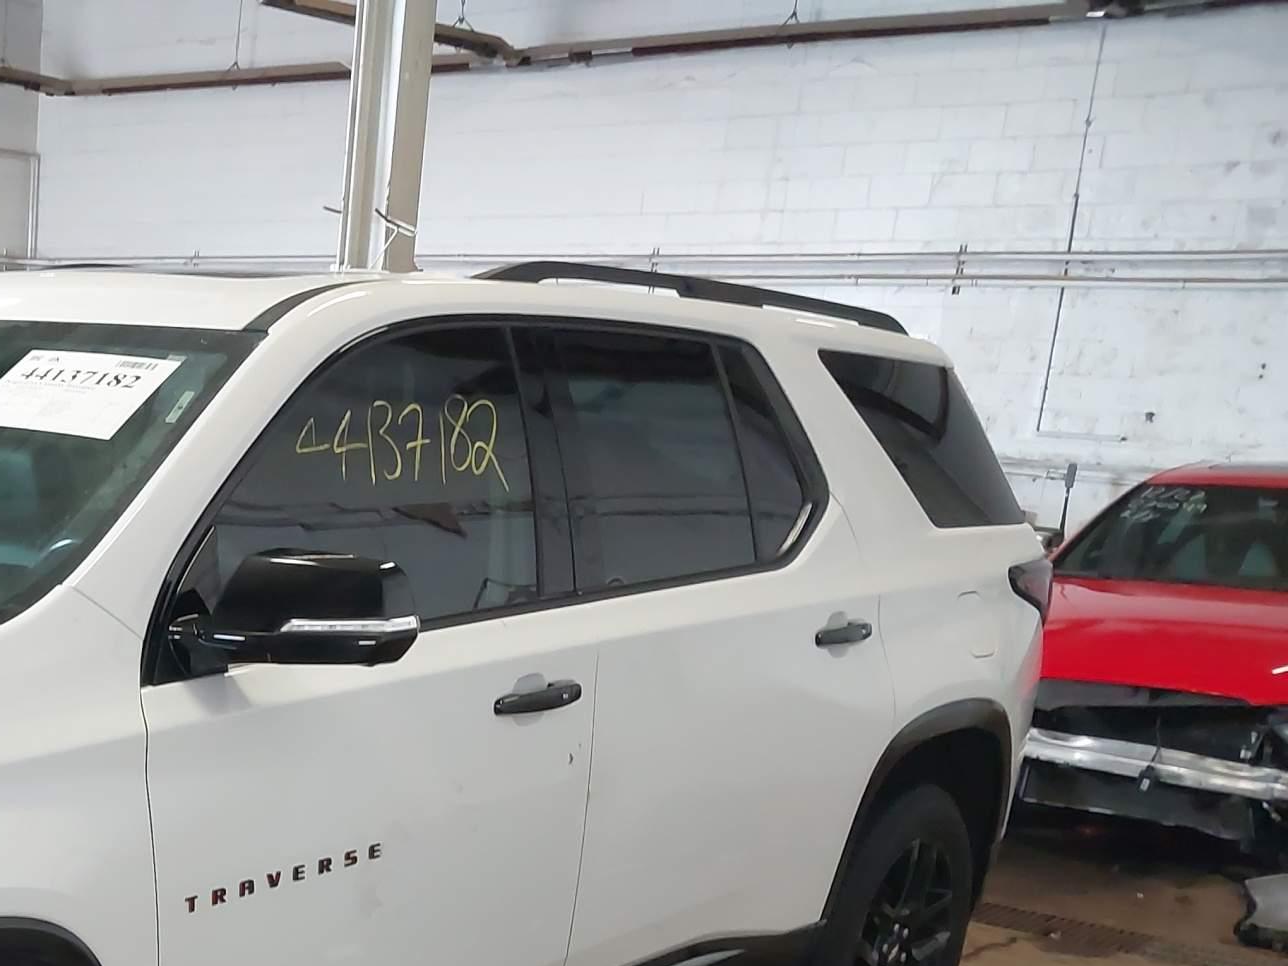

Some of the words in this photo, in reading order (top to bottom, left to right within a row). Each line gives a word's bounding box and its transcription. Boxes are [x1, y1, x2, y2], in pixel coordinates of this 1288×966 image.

[21, 367, 142, 389] 44137182
[295, 393, 510, 493] 44137182
[184, 842, 383, 914] TRAVERSE
